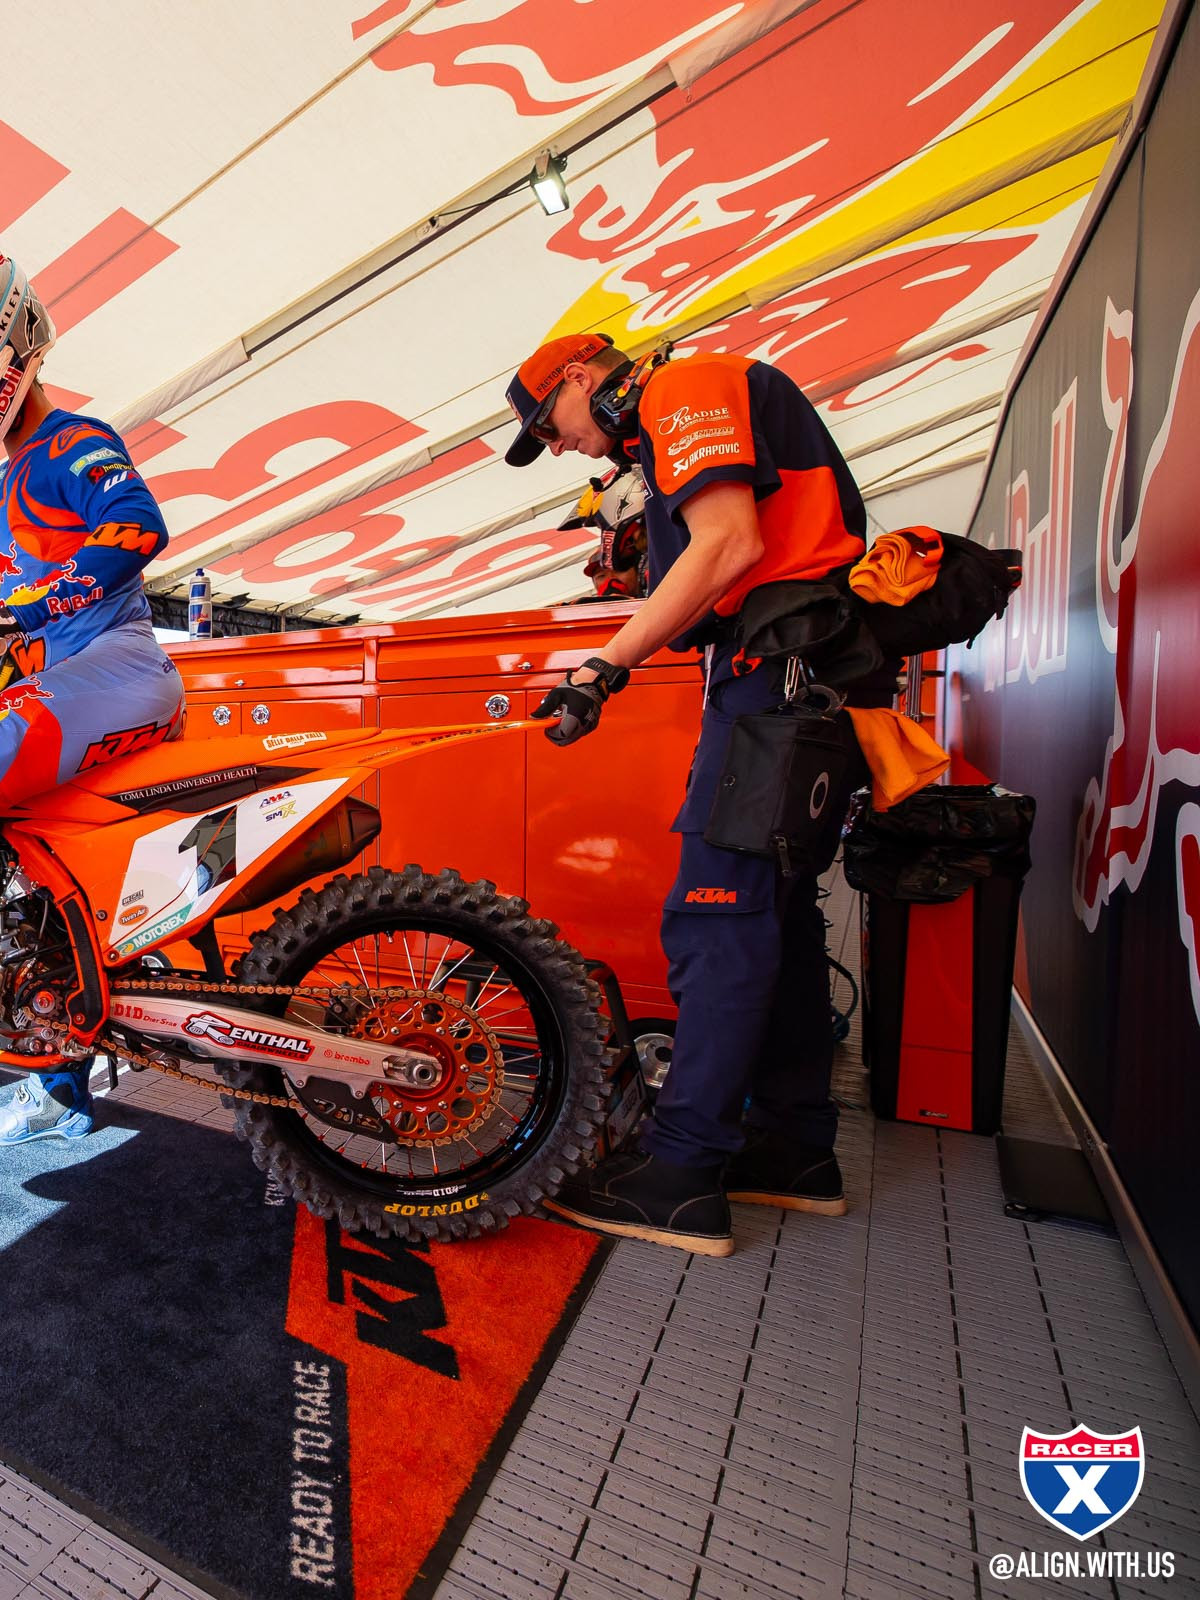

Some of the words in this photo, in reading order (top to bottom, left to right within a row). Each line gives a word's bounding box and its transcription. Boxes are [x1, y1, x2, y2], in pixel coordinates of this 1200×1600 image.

[535, 364, 567, 394] FACTORY
[567, 343, 597, 364] RACING
[656, 406, 729, 436] PARADISE
[75, 721, 171, 774] KTM
[266, 737, 284, 749] SELLE
[305, 731, 324, 741] VALLE
[120, 790, 145, 802] LOMA
[145, 785, 172, 797] LINDA
[172, 774, 222, 791] UNIVERSITY
[222, 766, 258, 781] HEALTH
[259, 790, 294, 809] AMA
[685, 887, 737, 904] KTM
[133, 912, 185, 948] MOTOREX
[113, 1002, 143, 1020] DID
[186, 1014, 310, 1055] RENTHAL
[334, 1053, 371, 1066] brembo
[383, 1194, 480, 1217] DUNLOP
[293, 1360, 332, 1426] RACE
[292, 1428, 333, 1464] TO
[290, 1471, 336, 1588] READY
